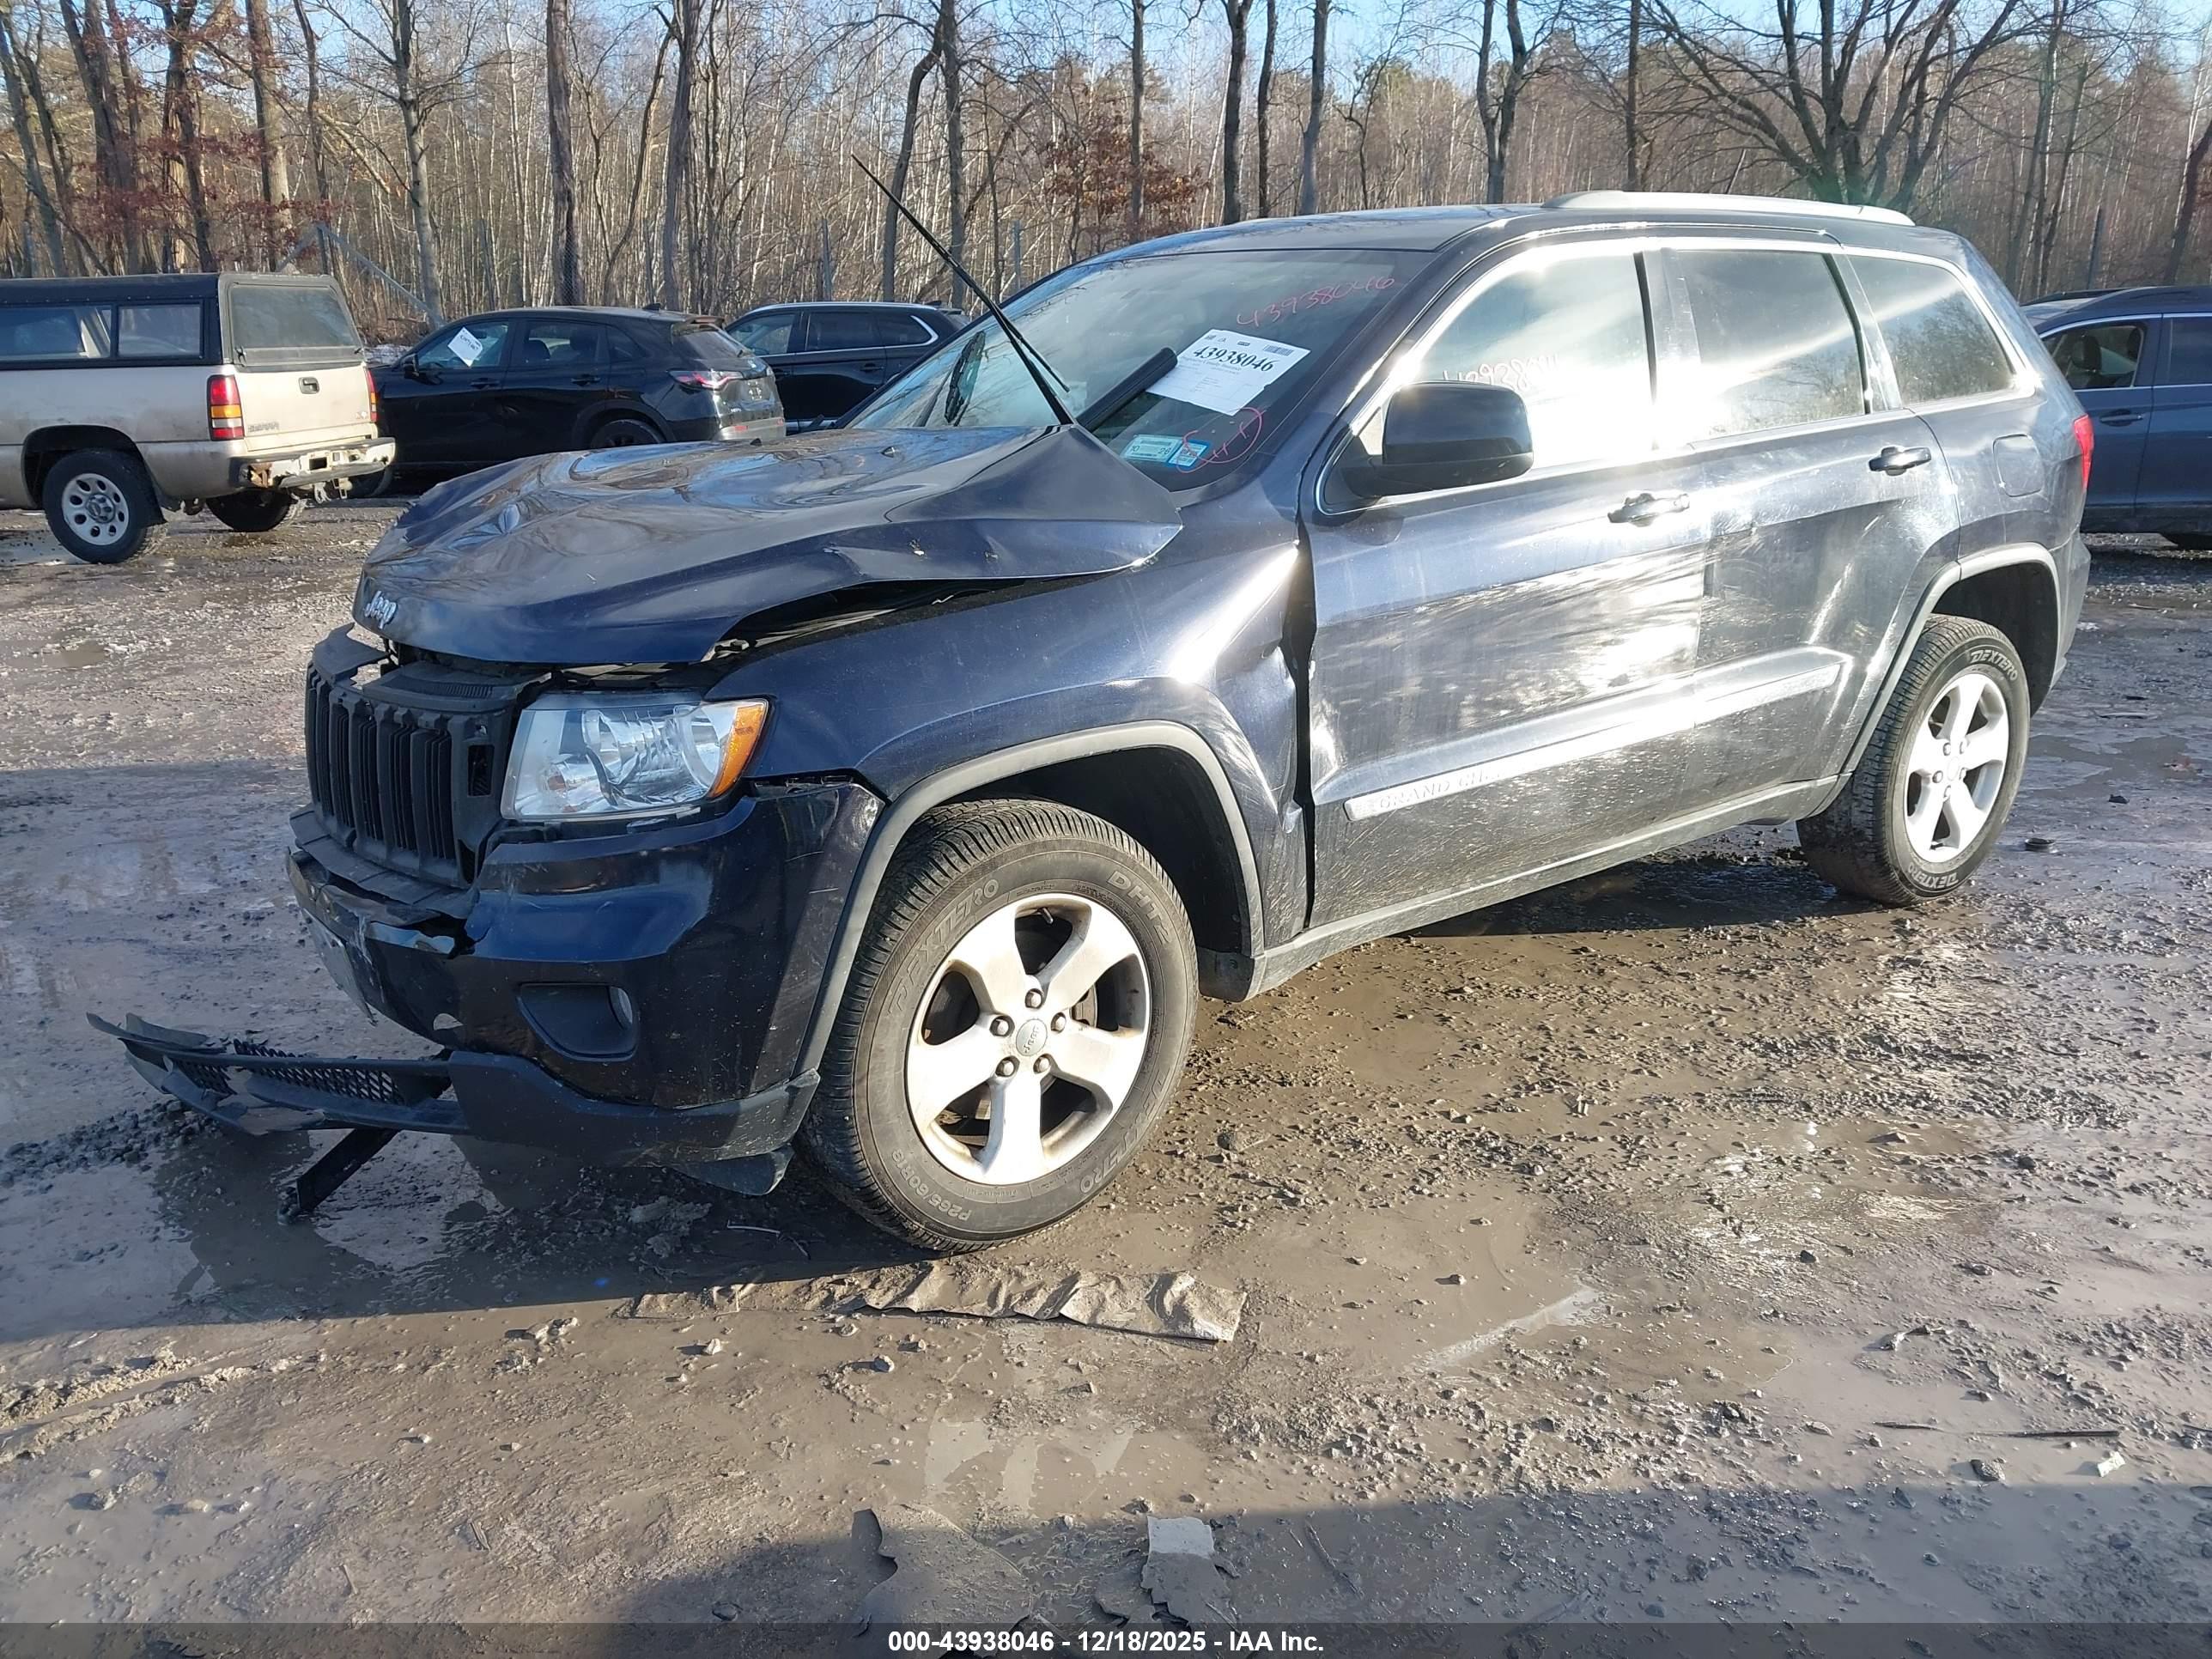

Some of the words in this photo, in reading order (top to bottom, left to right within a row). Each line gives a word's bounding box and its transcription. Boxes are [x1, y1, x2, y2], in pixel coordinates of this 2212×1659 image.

[1237, 276, 1395, 327] 43938046
[1193, 345, 1279, 372] 43938046
[364, 590, 398, 629] Jeep
[1969, 649, 2018, 681] DEXTERO
[1379, 780, 1450, 809] GRAND
[1908, 861, 1960, 889] DEXTERO
[1107, 870, 1173, 945] DHT2
[887, 878, 1000, 1014] DEXTERO
[891, 1148, 973, 1222] P265/60R18
